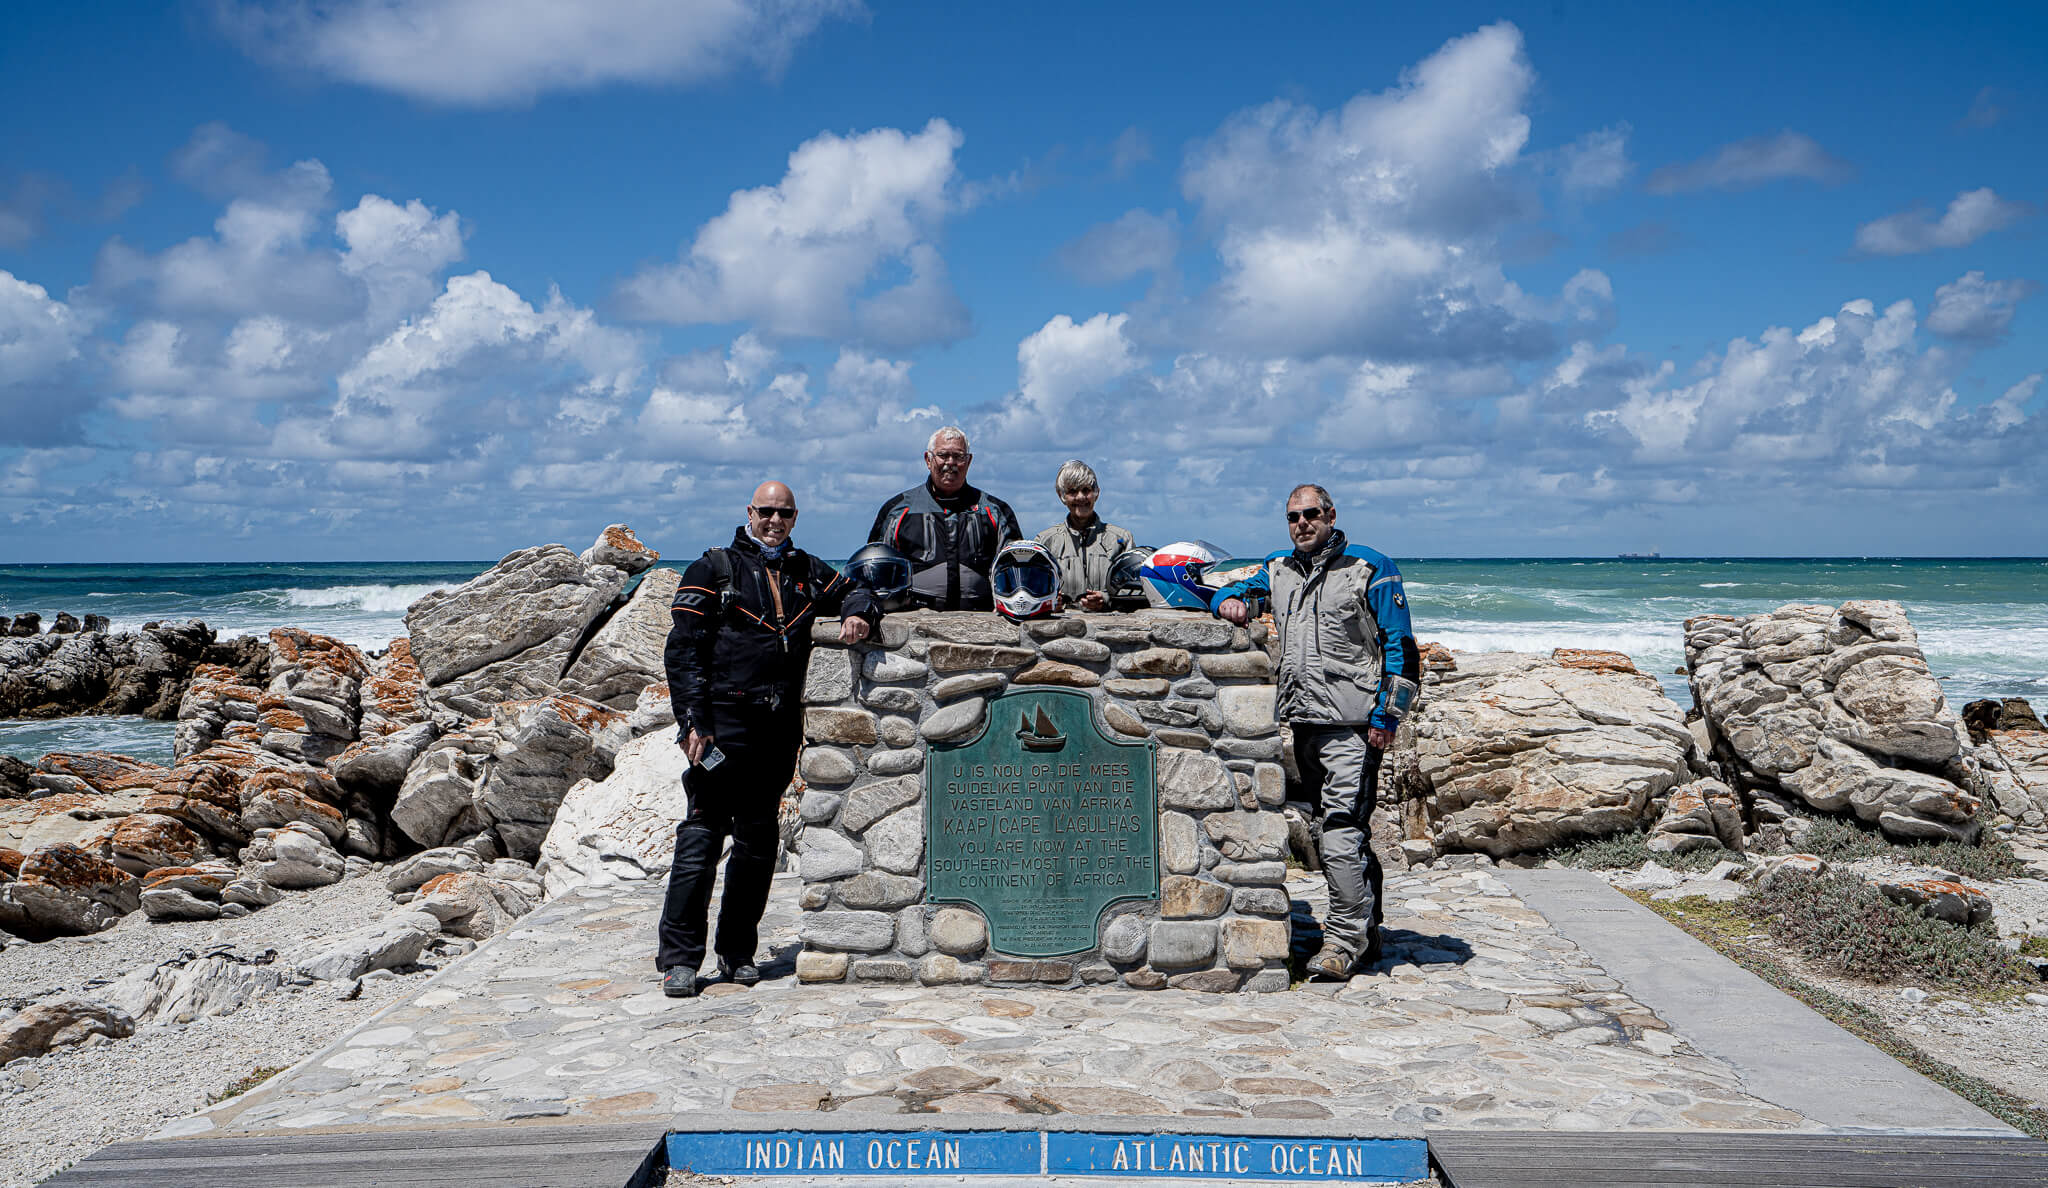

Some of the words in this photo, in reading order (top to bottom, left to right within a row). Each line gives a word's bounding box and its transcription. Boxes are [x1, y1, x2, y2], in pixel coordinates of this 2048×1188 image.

[953, 766, 963, 777] U
[971, 766, 985, 777] IS
[993, 765, 1023, 777] NOU
[1031, 765, 1050, 777] OP
[1058, 764, 1081, 777] DIE
[1090, 764, 1130, 776] MEES
[947, 782, 1020, 794] SUIDELIKE
[1028, 781, 1065, 793] PUNT
[1074, 781, 1103, 793] VAN
[1111, 781, 1135, 793] DIE
[951, 799, 1034, 811] VASTELAND
[1043, 799, 1071, 810] VAN
[1080, 798, 1133, 810] AFRIKA
[1055, 814, 1141, 834] L'AGULHAS
[959, 842, 986, 854] YOU
[995, 840, 1024, 853] ARE
[1033, 840, 1065, 852] NOW
[1075, 840, 1092, 852] AT
[1100, 839, 1128, 852] THE
[934, 857, 1058, 872] SOUTHERN-MOST
[1069, 857, 1089, 870] TIP
[1099, 857, 1115, 869] OF
[1126, 856, 1152, 869] THE
[959, 874, 1037, 888] CONTINENT
[1046, 873, 1065, 886] OF
[1073, 873, 1126, 886] AFRICA
[745, 1139, 845, 1170] INDIAN
[866, 1139, 961, 1169] OCEAN
[1111, 1140, 1249, 1173] ATLANTIC
[1270, 1143, 1363, 1176] OCEAN
